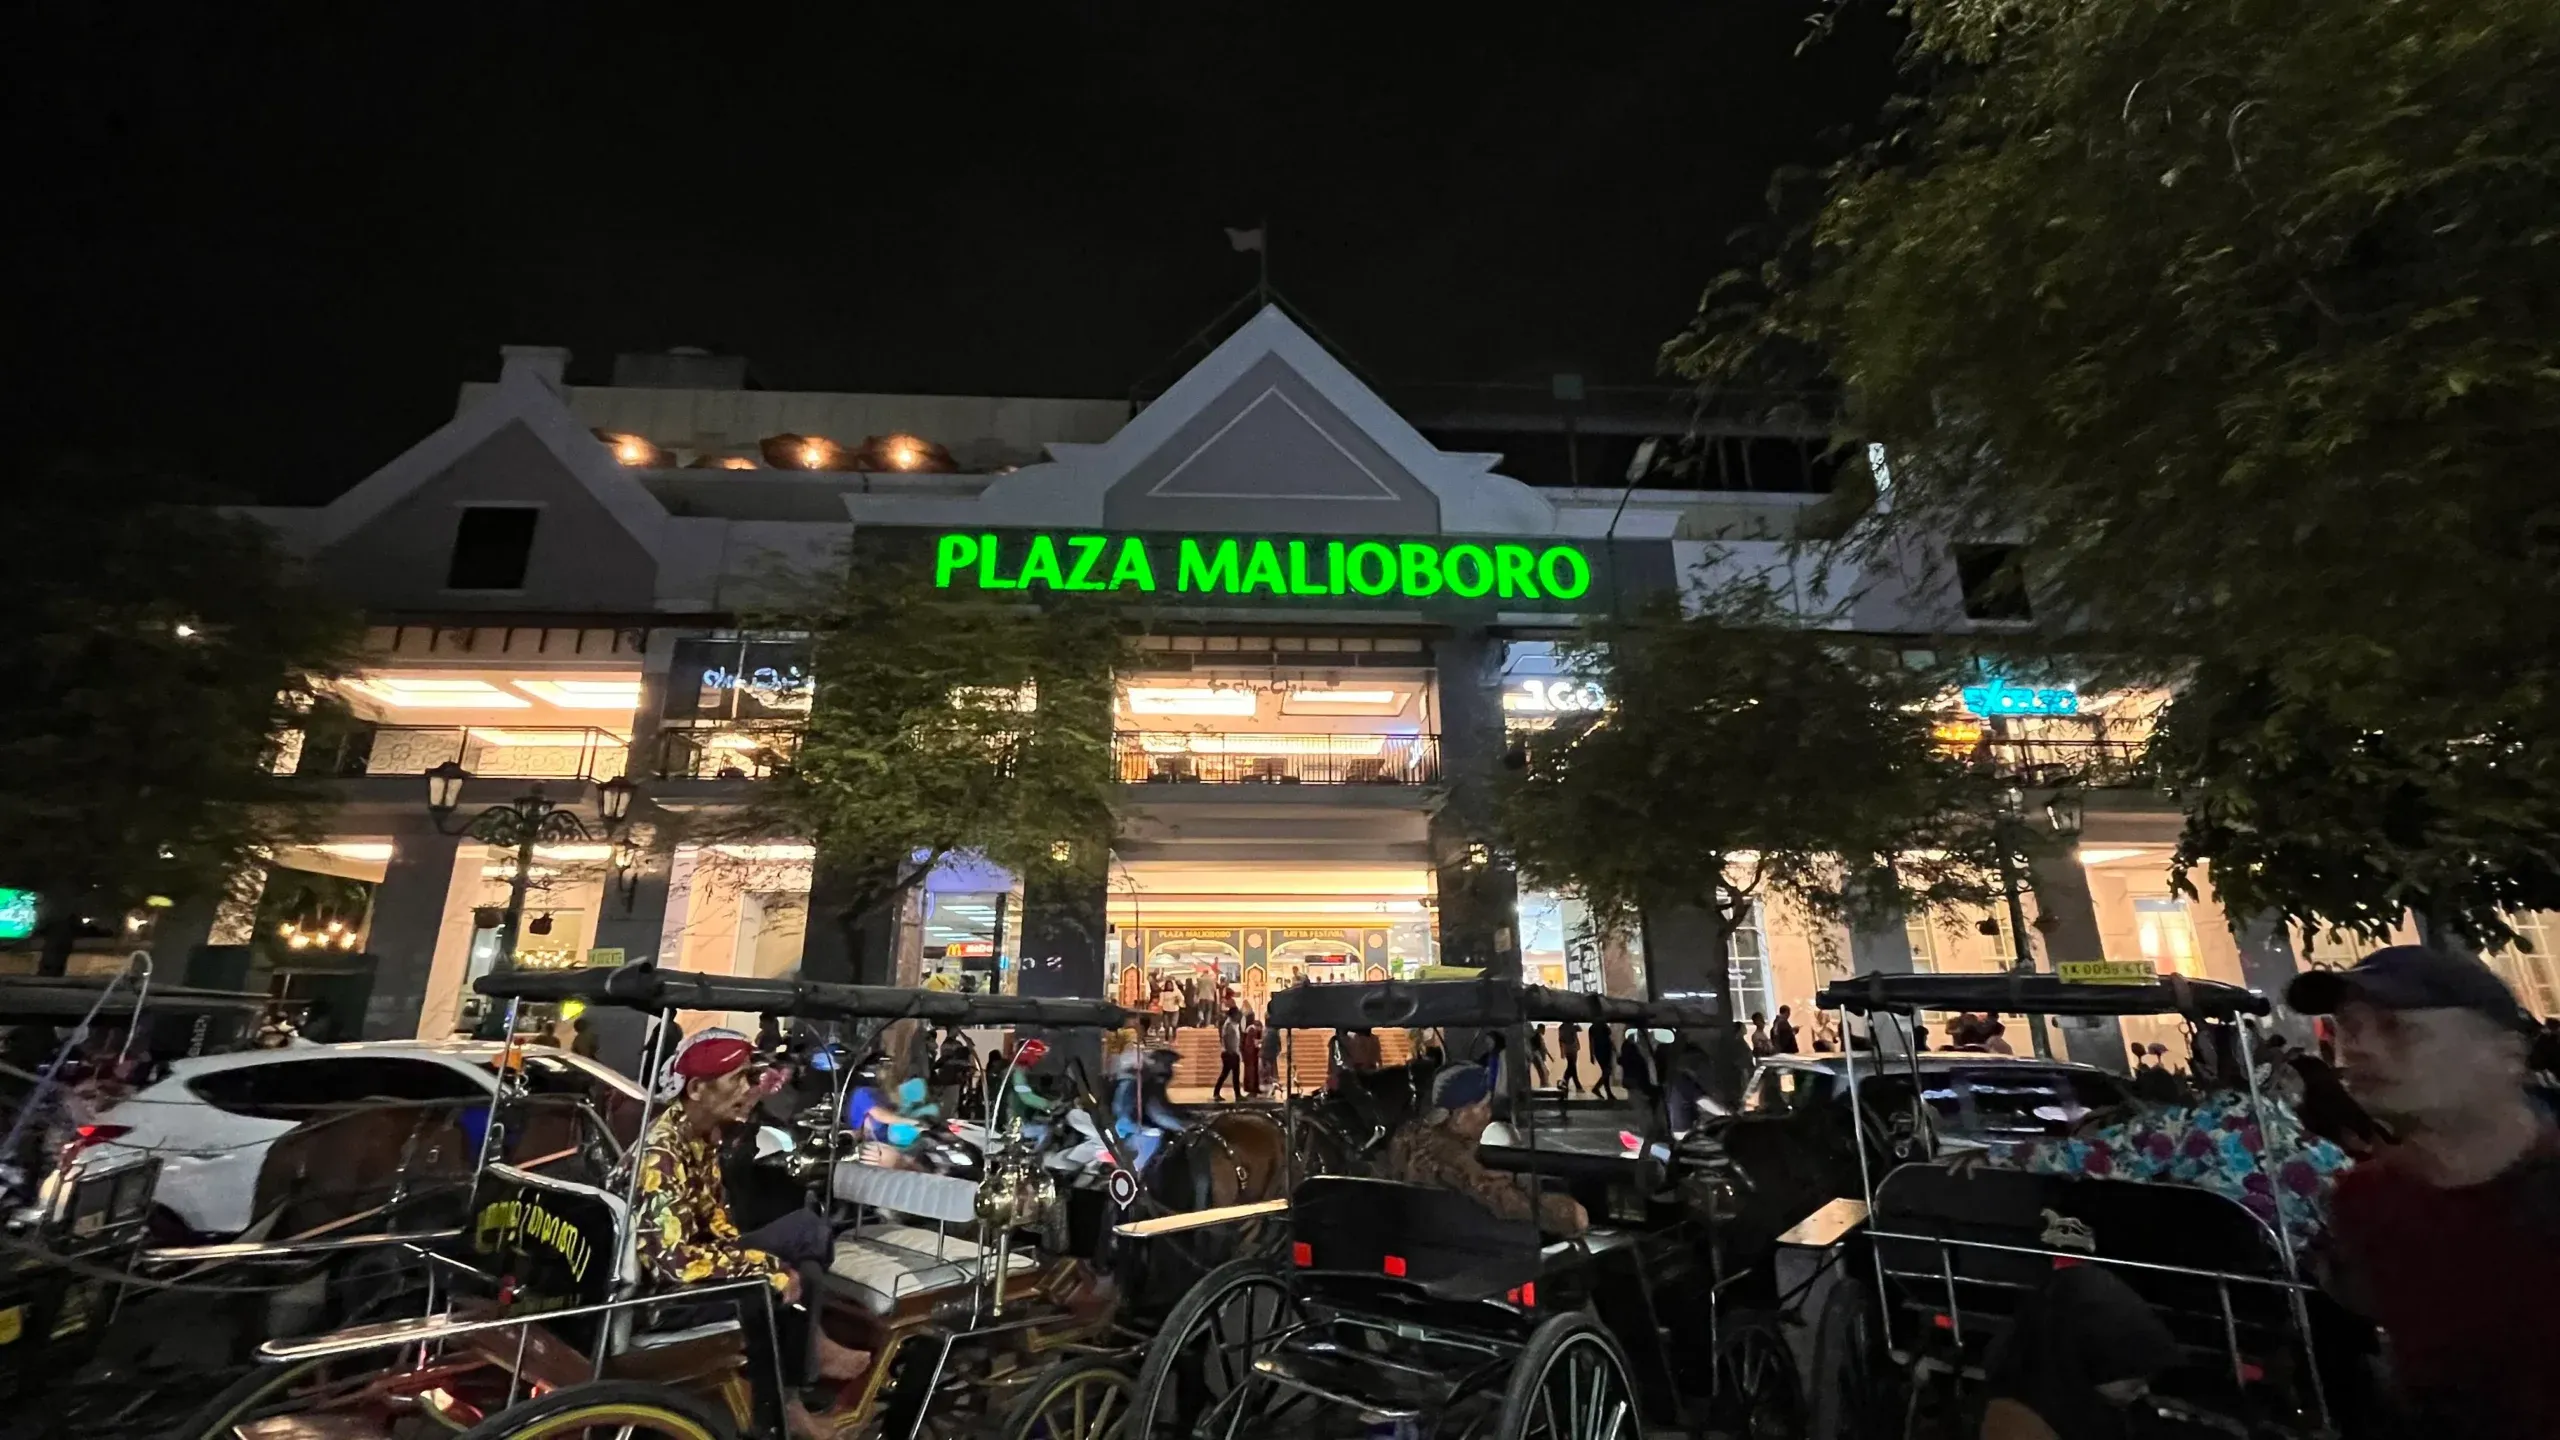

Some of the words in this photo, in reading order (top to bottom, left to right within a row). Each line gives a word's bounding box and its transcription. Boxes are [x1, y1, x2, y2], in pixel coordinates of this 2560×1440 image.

[935, 534, 1156, 591] PLAZA
[1178, 539, 1591, 600] MALIOBORO
[1158, 930, 1185, 938] PLAZA
